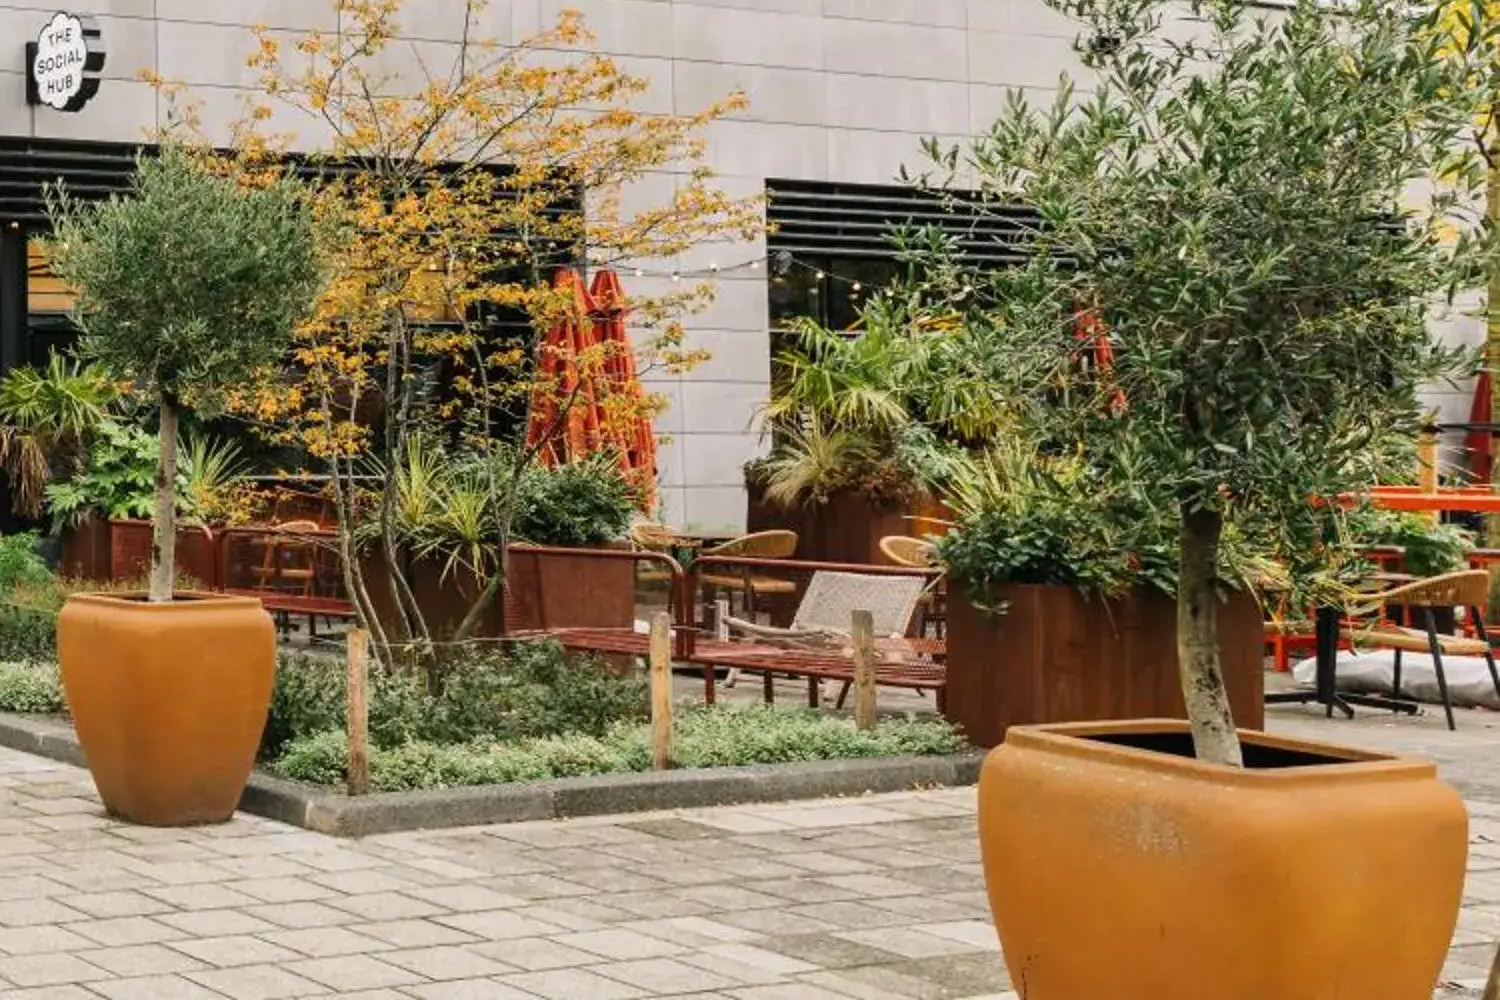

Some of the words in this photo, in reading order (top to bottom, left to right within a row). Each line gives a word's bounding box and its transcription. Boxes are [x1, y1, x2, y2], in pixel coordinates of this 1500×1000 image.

[48, 27, 73, 46] THE
[37, 47, 83, 75] SOCIAL
[47, 74, 73, 94] HUB
